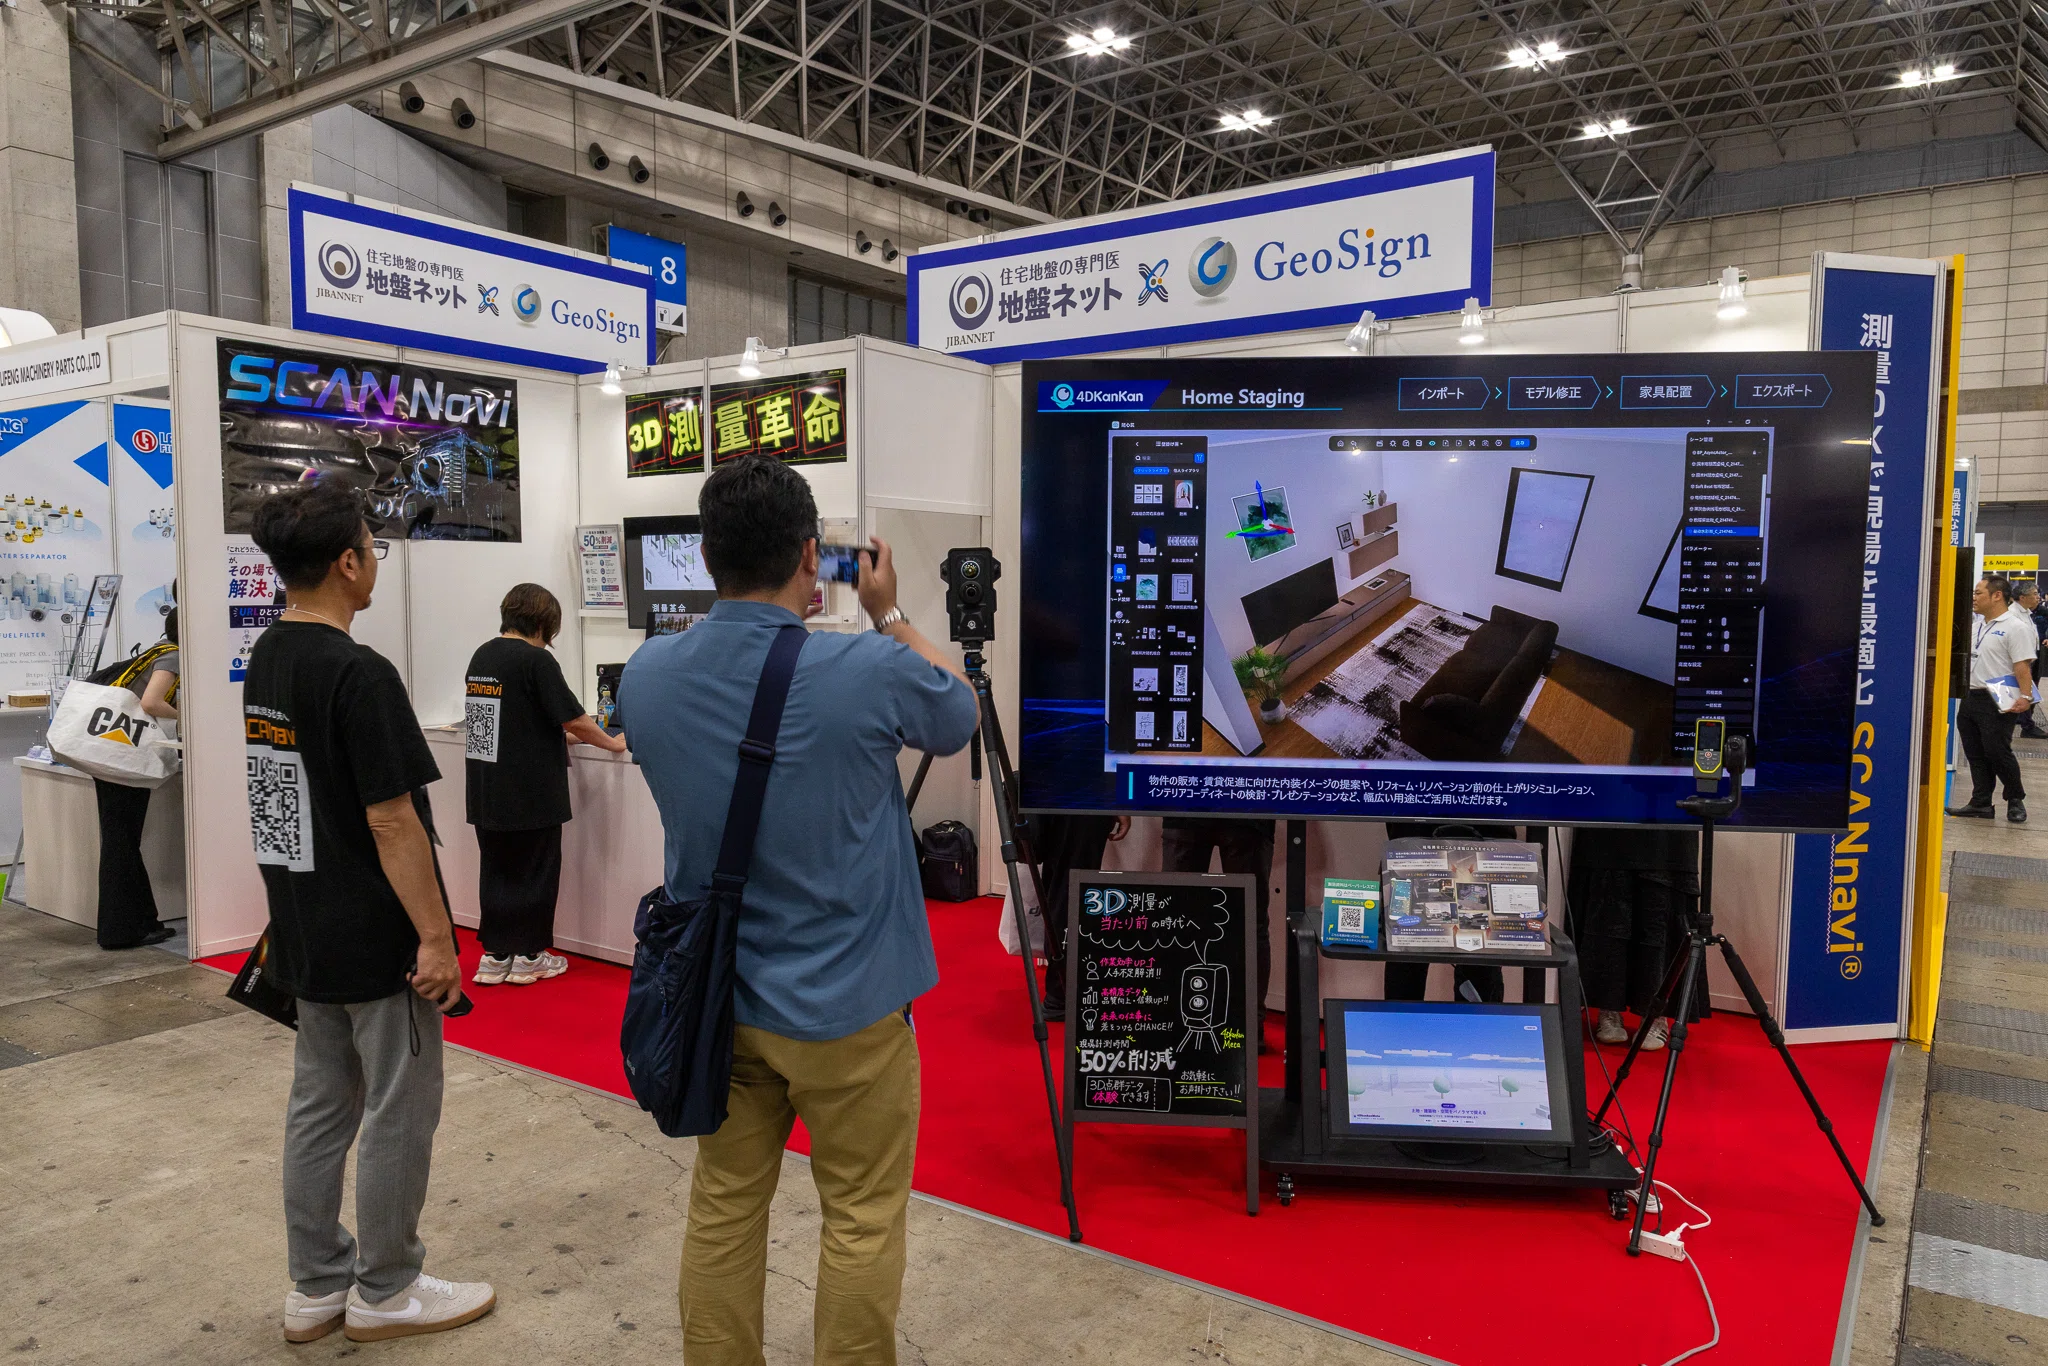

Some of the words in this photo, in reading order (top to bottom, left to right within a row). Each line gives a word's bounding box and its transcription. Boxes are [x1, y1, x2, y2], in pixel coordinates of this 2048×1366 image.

[1253, 228, 1431, 280] GeoSign
[366, 248, 465, 282] 住宅地盤の専門医
[661, 256, 677, 285] 8
[1000, 250, 1120, 287] 住宅地盤の専門医
[316, 287, 364, 304] JIBANNET
[366, 267, 468, 309] 地盤ネット
[999, 277, 1123, 324] 地盤ネット
[551, 299, 640, 344] GeoSign
[945, 331, 995, 349] JIBANNET
[20, 361, 55, 383] MACHINERY
[55, 357, 75, 375] PARTS
[1076, 390, 1144, 403] 4DKanKan
[1182, 389, 1233, 405] Home
[1238, 388, 1305, 408] Staging
[1418, 386, 1465, 400] インポート
[1525, 385, 1582, 399] モデル修正
[1639, 385, 1693, 399] 家具配置
[1752, 384, 1813, 398] エクスポート
[228, 563, 274, 577] その場で
[228, 578, 274, 599] 解決。
[1084, 888, 1172, 916] 3D測量が
[1100, 914, 1201, 931] 当たり前の時代へ
[1100, 987, 1141, 997] 高精度データ
[1100, 1009, 1153, 1021] 未来の仕事に
[1079, 1038, 1130, 1049] 現場計測時間
[1079, 1046, 1177, 1073] 50%削減
[1180, 1069, 1216, 1082] お気軽に
[1089, 1079, 1144, 1092] 3D点群データ
[1092, 1090, 1150, 1104] 体験できます
